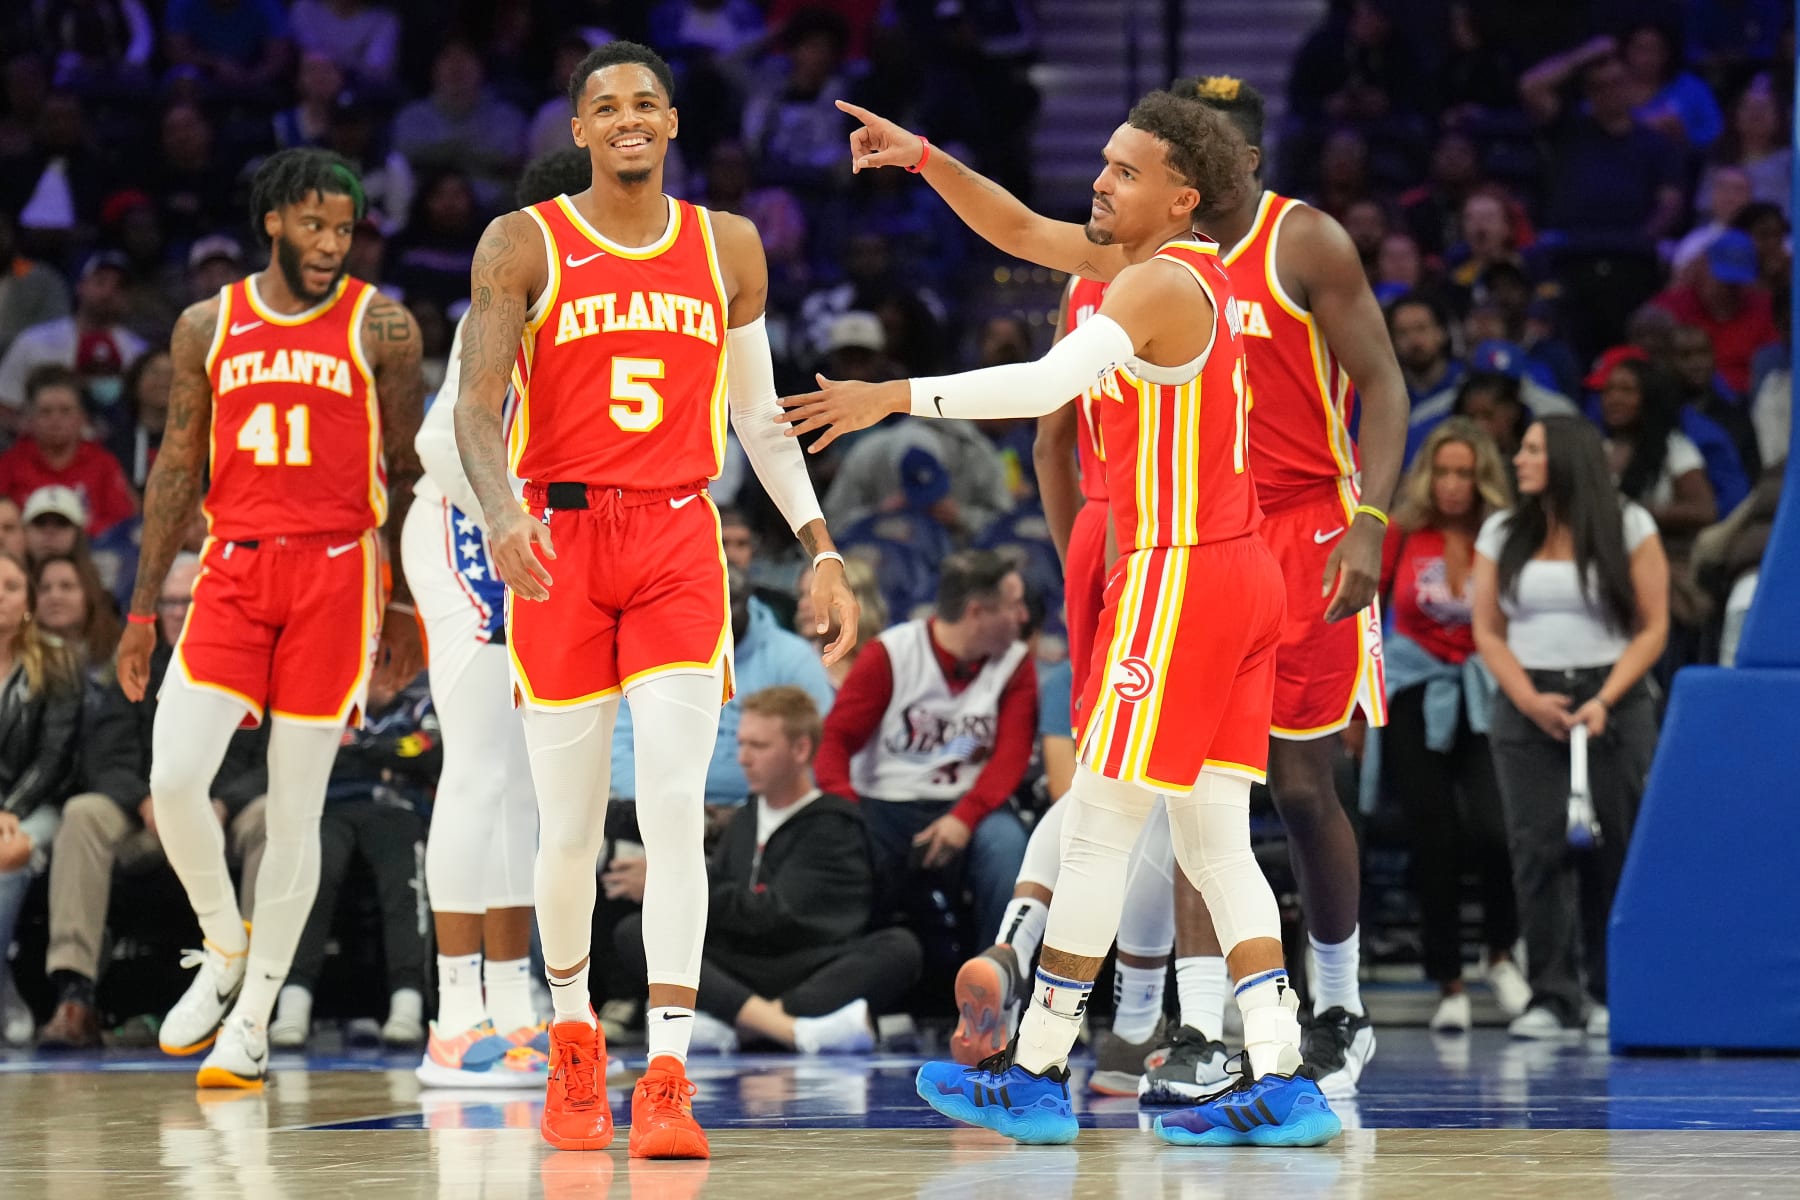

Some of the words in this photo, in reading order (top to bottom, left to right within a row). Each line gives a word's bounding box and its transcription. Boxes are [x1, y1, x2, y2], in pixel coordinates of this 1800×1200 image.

[555, 291, 718, 347] ATLANTA
[218, 349, 353, 398] ATLANTA
[608, 355, 665, 433] 5
[237, 402, 312, 467] 41
